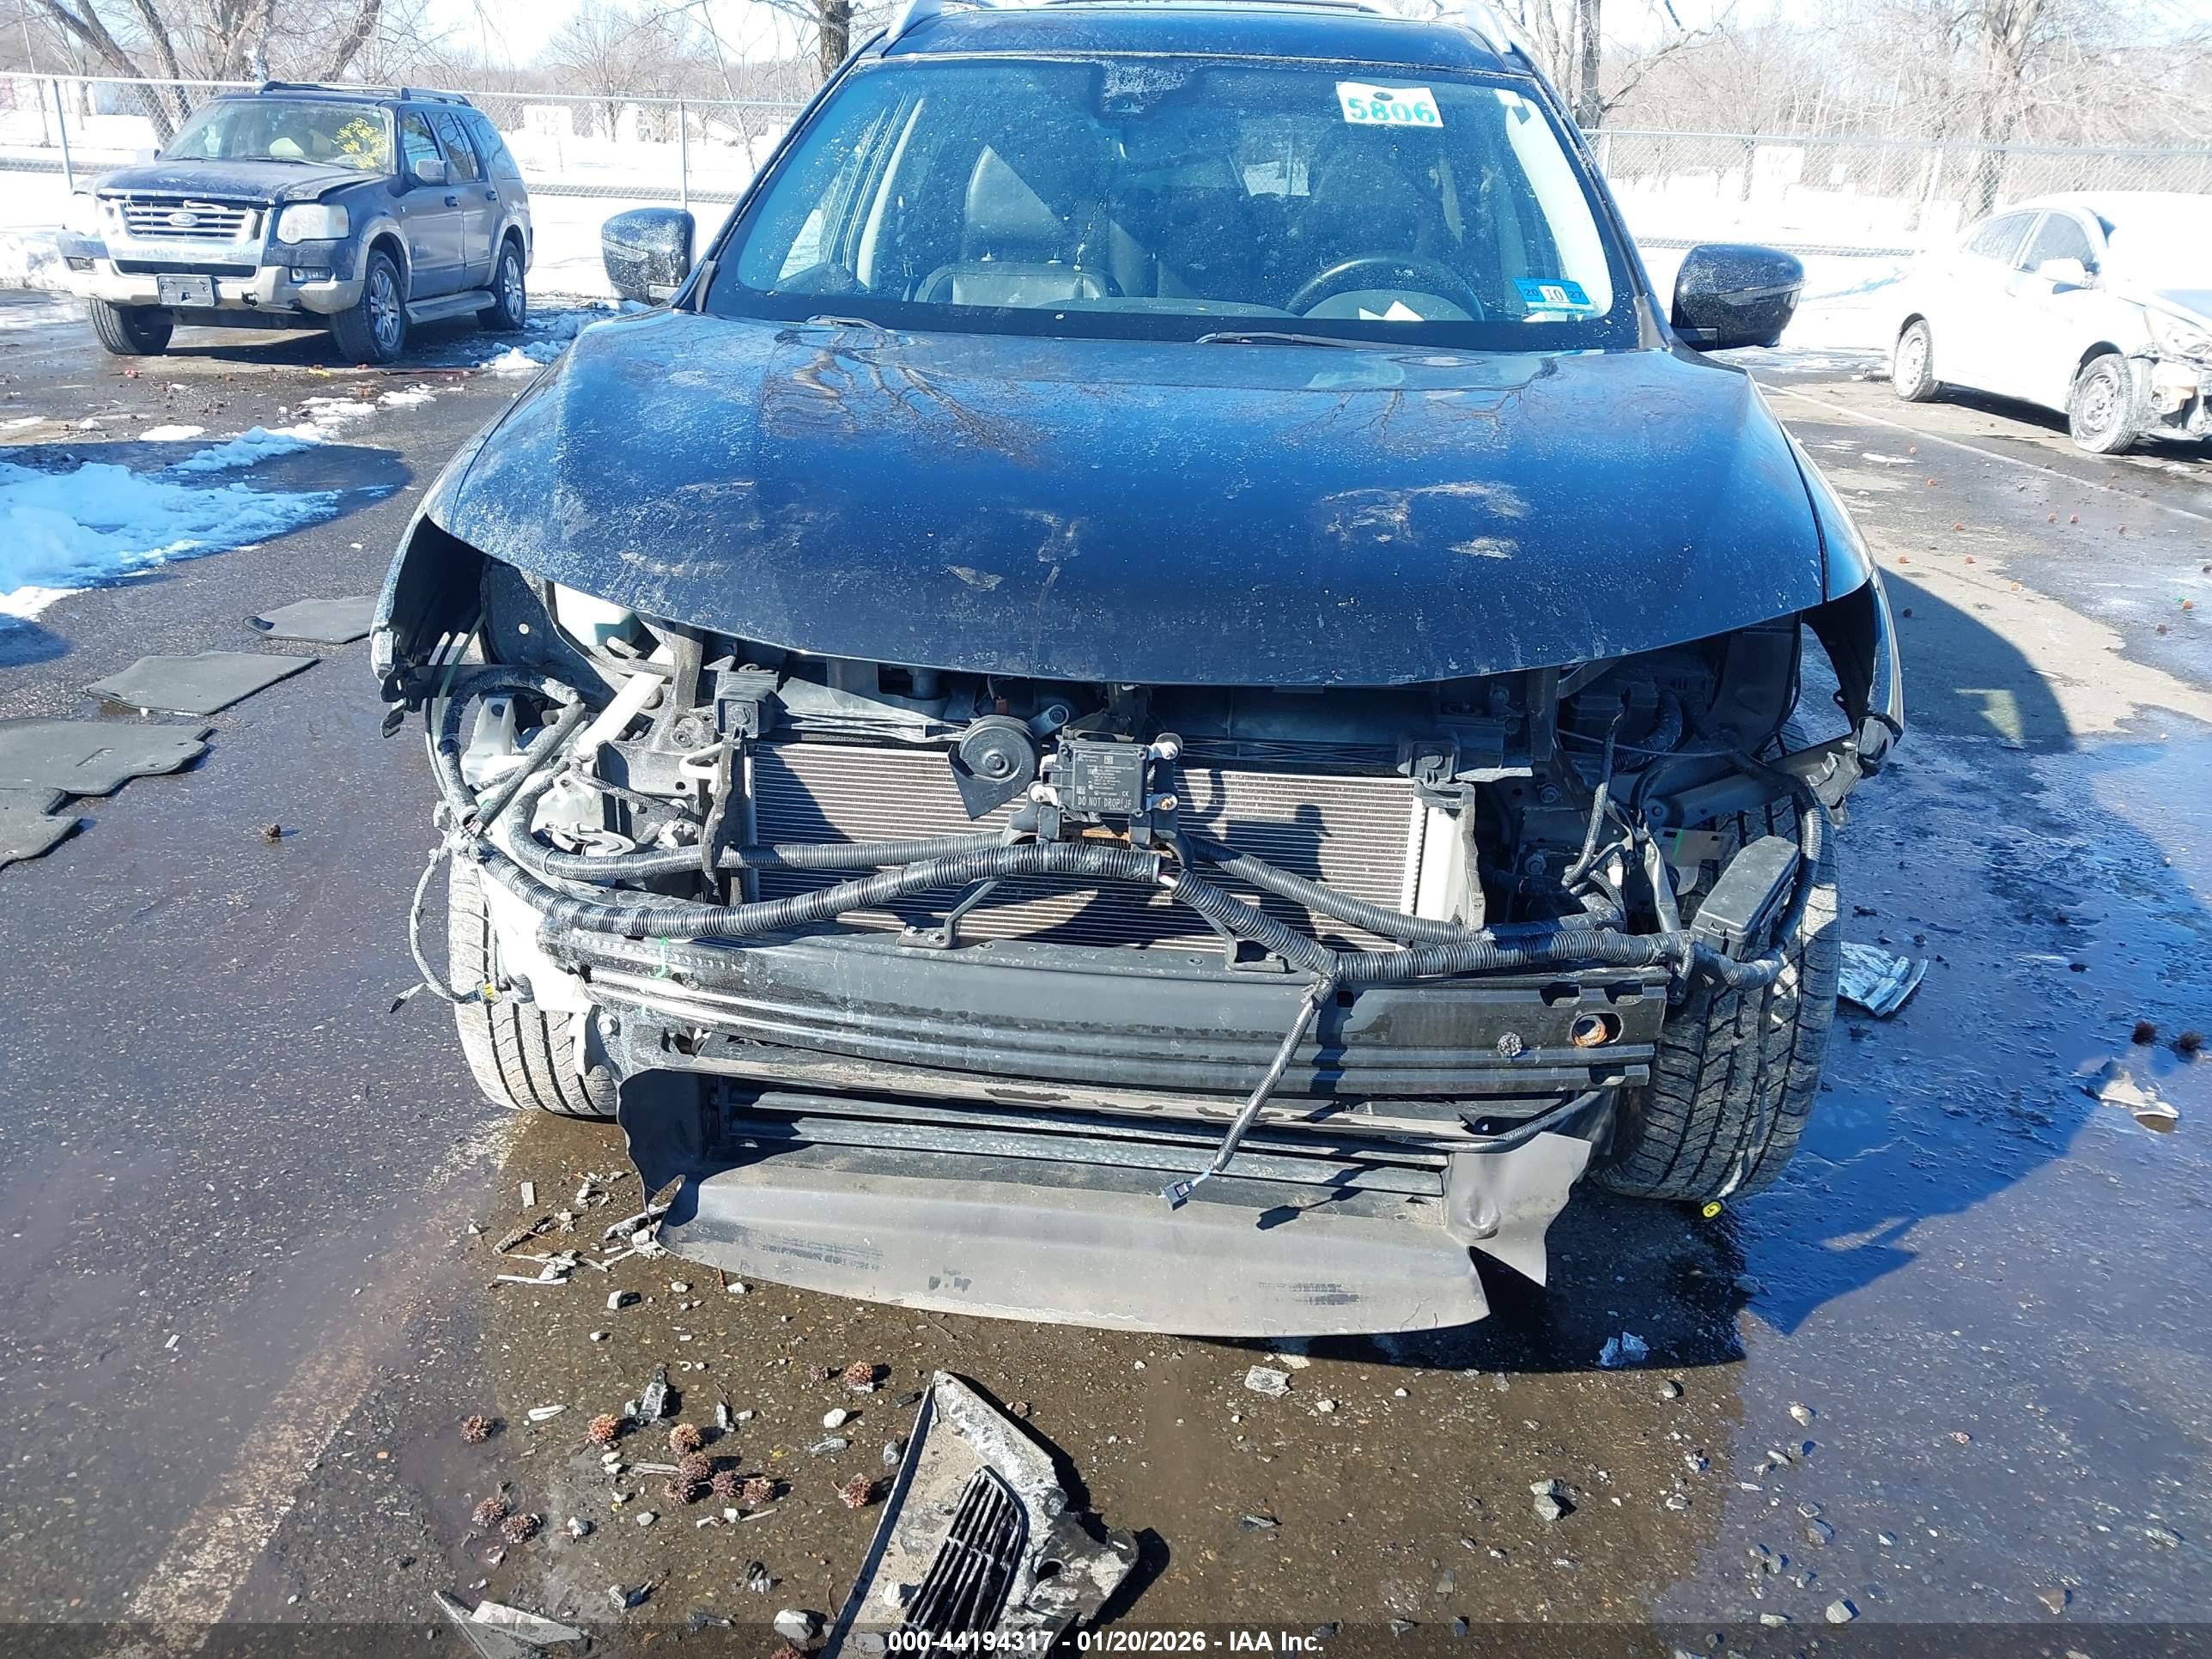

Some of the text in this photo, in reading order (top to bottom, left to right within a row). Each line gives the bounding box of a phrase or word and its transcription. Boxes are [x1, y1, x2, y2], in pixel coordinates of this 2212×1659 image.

[1347, 97, 1435, 124] 5806
[1524, 288, 1583, 301] 20 10 27
[1078, 795, 1087, 806] DO
[1088, 796, 1102, 807] NOT
